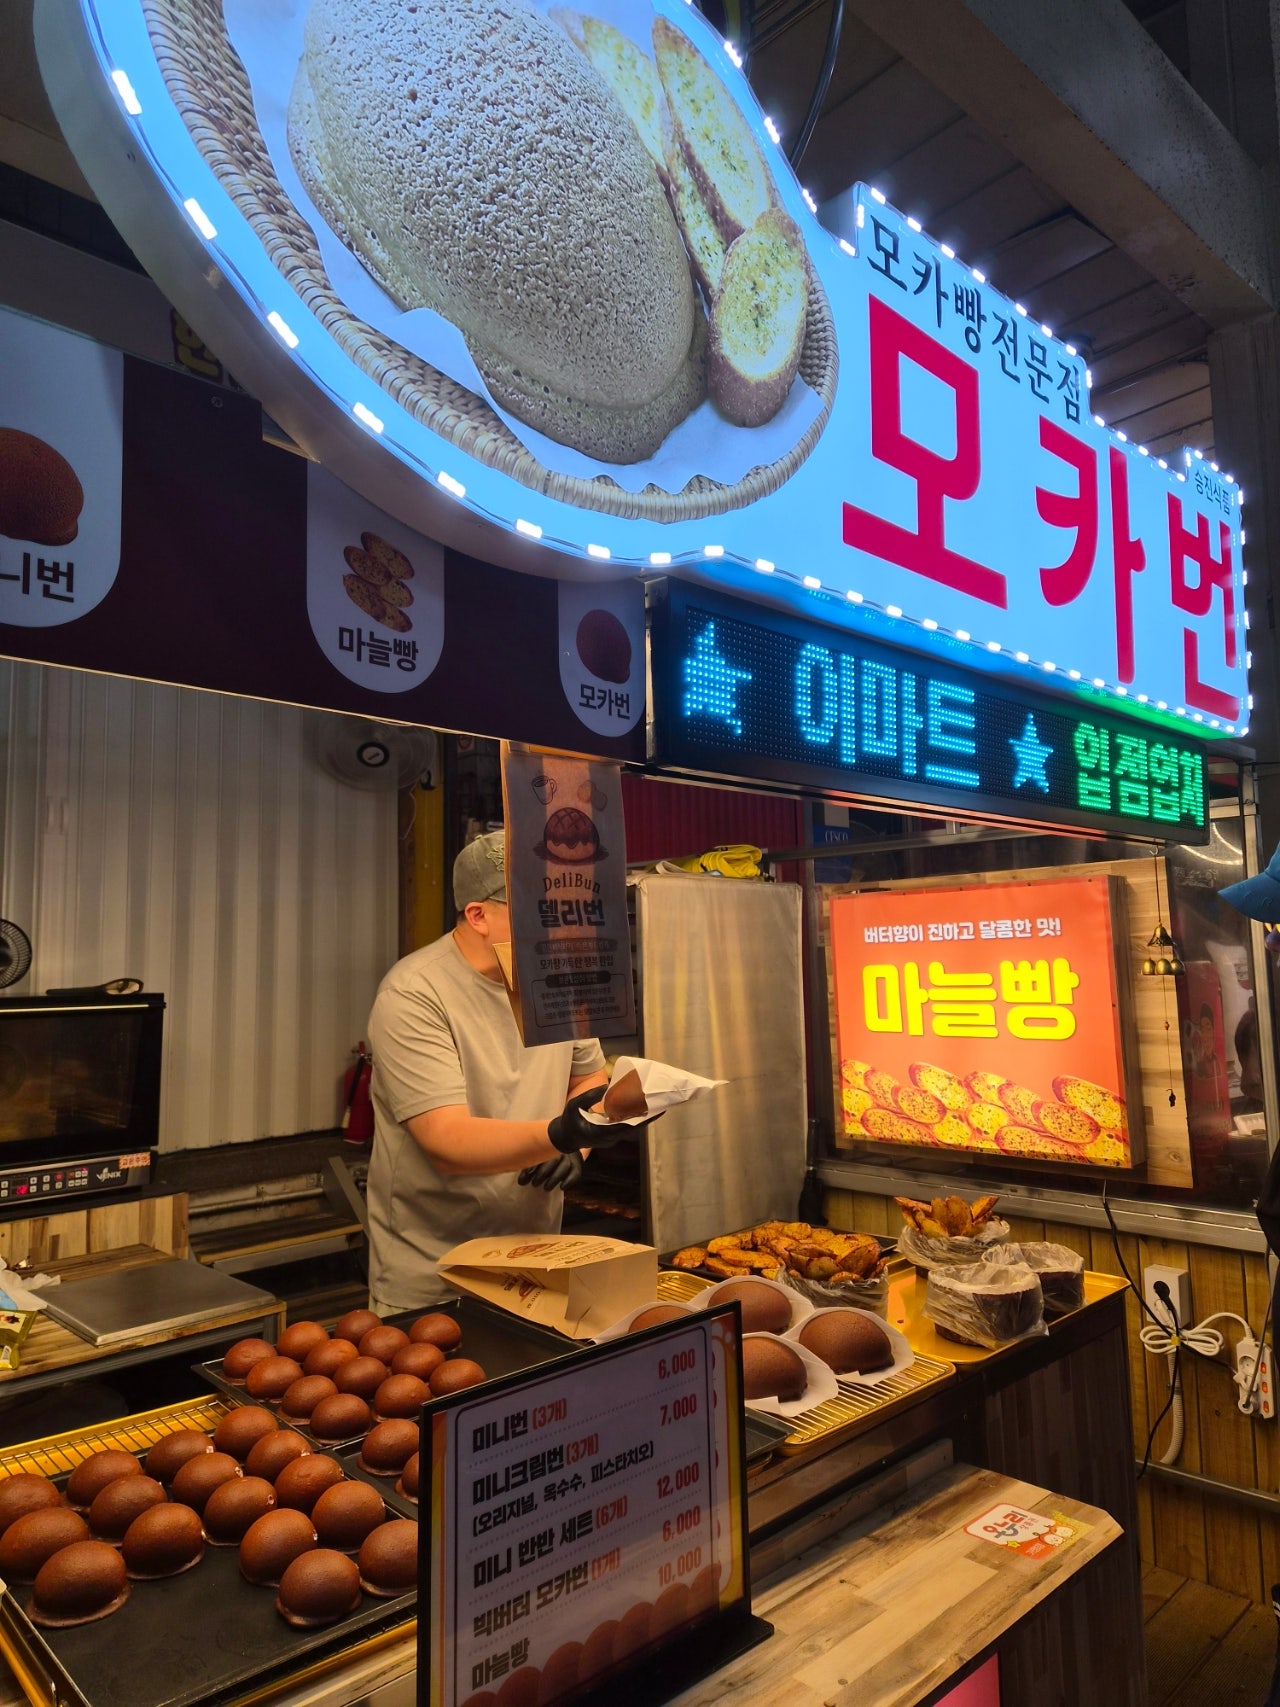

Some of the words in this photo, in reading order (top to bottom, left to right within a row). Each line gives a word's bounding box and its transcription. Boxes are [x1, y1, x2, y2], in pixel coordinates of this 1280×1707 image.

[867, 214, 1081, 425] 모카빵전문점
[842, 292, 1241, 722] 모카번
[1195, 470, 1230, 515] 승진식품
[339, 627, 419, 672] 마늘빵
[579, 684, 631, 720] 모카번
[795, 642, 980, 786] 이마트
[538, 898, 605, 928] 델리번
[543, 872, 601, 894] DeliBun
[864, 924, 924, 944] 버터향이
[927, 921, 975, 941] 진하고
[979, 918, 1032, 939] 달콤한
[1036, 917, 1061, 938] 맛!
[862, 957, 1080, 1040] 마늘빵
[473, 1409, 528, 1453] 미니번
[658, 1349, 696, 1380] 6,000
[473, 1444, 564, 1505] 미니크림번
[660, 1393, 697, 1426] 7,000
[591, 1440, 654, 1483] 피스타치오)
[473, 1548, 512, 1589] 미니
[518, 1527, 555, 1568] 반반
[559, 1509, 594, 1546] 세트
[656, 1461, 700, 1499] 12,000
[536, 1560, 589, 1610] 모카번
[662, 1505, 701, 1542] 6,000
[472, 1637, 530, 1691] 마늘빵
[658, 1546, 701, 1587] 10,000
